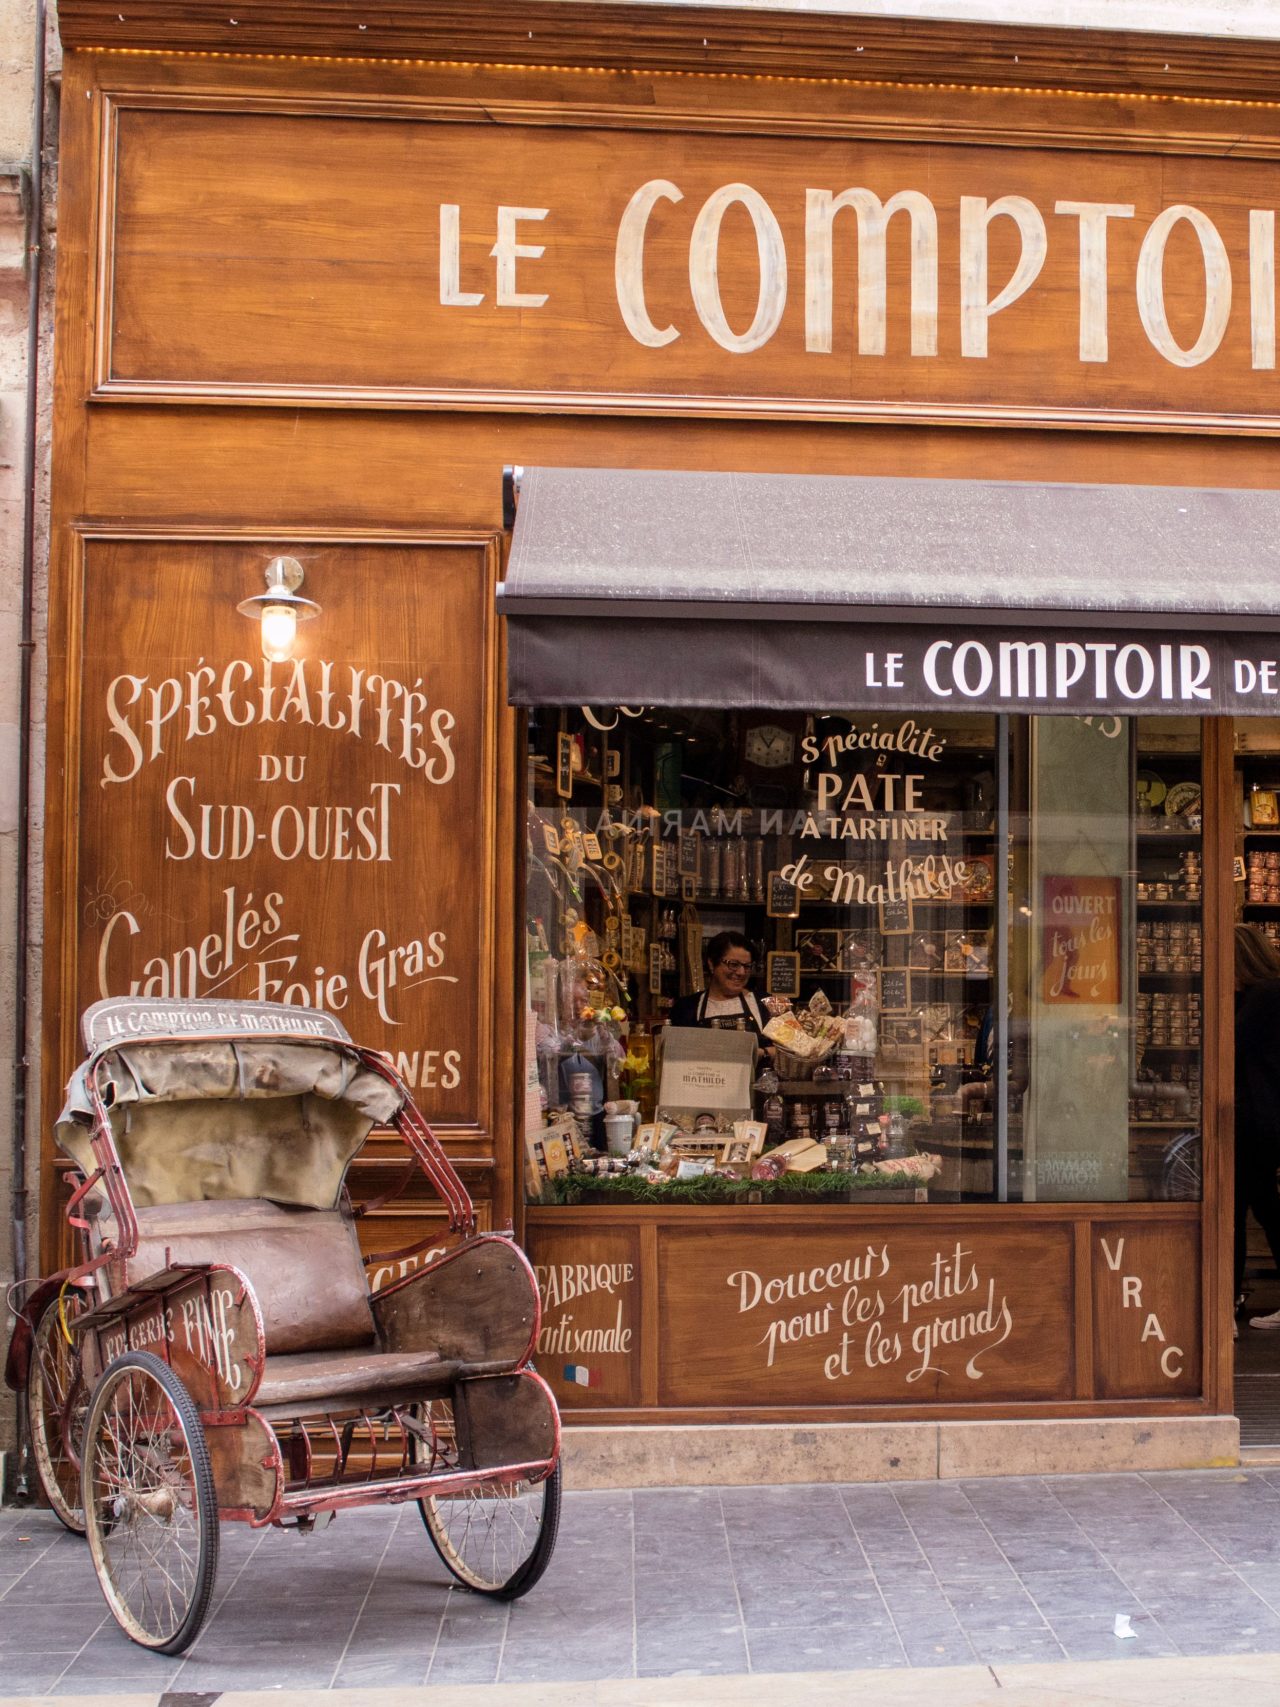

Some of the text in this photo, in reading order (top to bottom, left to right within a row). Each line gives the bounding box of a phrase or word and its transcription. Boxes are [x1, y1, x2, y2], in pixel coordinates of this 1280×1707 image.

[438, 203, 550, 309] LE
[865, 651, 904, 688] LE
[922, 640, 1213, 700] COMPTOIR
[1234, 659, 1279, 695] DE
[99, 655, 457, 790] SPÉCIALITÉS
[800, 719, 947, 768] Spécialité
[258, 754, 307, 783] DU
[816, 772, 926, 813] PATE
[165, 775, 401, 863] SUD-OUEST
[826, 816, 948, 842] TARTINER
[779, 853, 814, 893] de
[822, 854, 975, 906] Mathilde
[1051, 895, 1117, 915] OUVERT
[99, 885, 286, 999] Canelés
[1051, 916, 1114, 958] tous les
[248, 928, 460, 1026] Foie Gras
[1049, 952, 1109, 998] jours
[106, 1016, 126, 1036] LE
[533, 1263, 635, 1314] FABRIQUE
[726, 1243, 892, 1313] Douceurs
[758, 1242, 980, 1367] pour les petits
[536, 1299, 633, 1356] artisanale
[824, 1277, 1013, 1384] et les grands
[1099, 1237, 1184, 1380] VRAC
[181, 1289, 242, 1391] FINE
